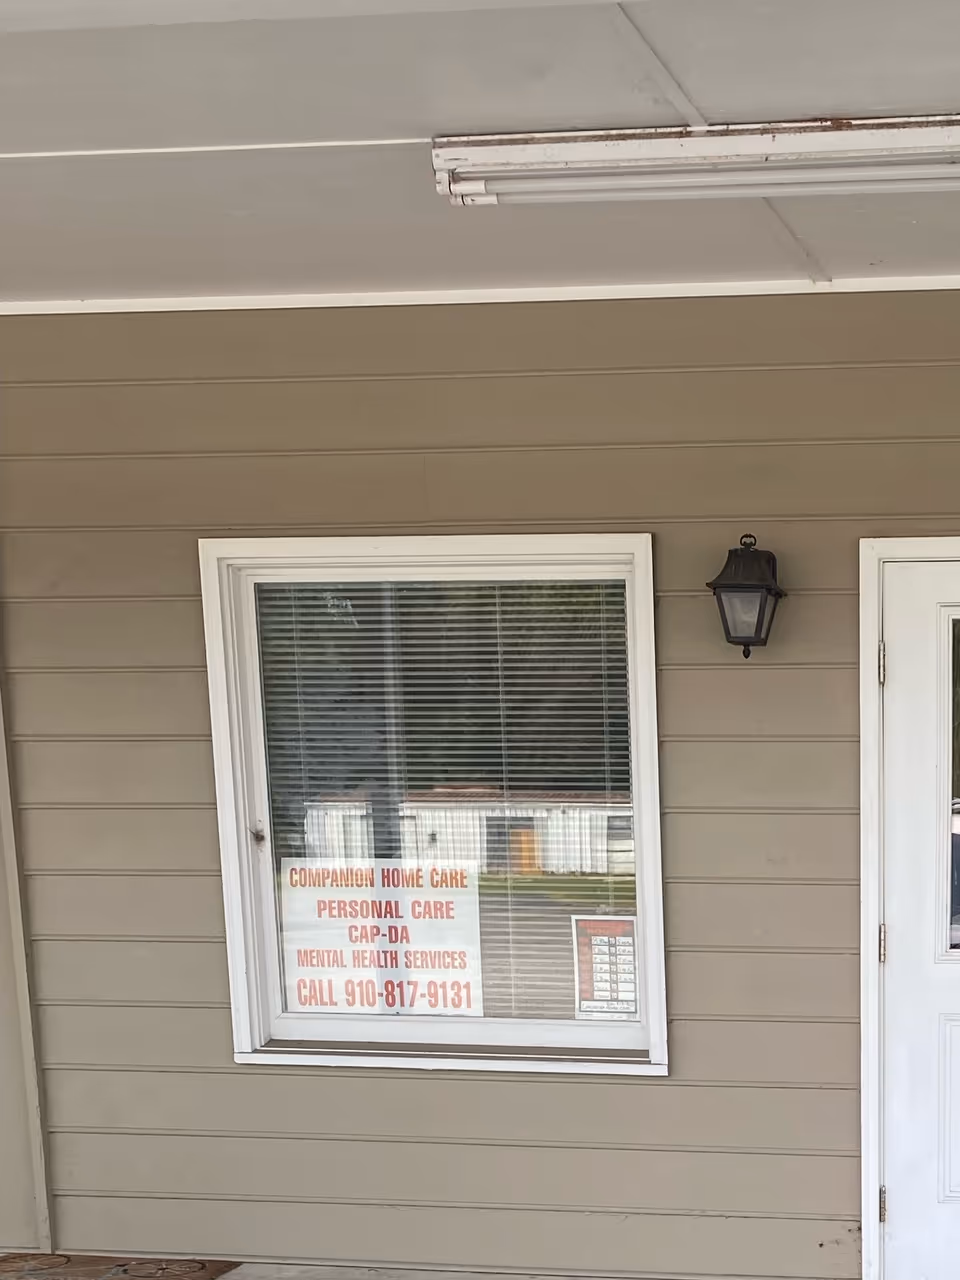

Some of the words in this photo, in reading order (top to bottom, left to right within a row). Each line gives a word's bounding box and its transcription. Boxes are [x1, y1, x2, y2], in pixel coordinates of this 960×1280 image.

[289, 867, 375, 888] COMPANION
[381, 868, 424, 888] HOME
[430, 867, 468, 889] CARE
[316, 900, 404, 919] PERSONAL
[411, 901, 455, 920] CARE
[348, 925, 410, 944] CAP-DA
[297, 949, 347, 968] MENTAL
[352, 949, 399, 969] HEALTH
[404, 950, 468, 970] SERVICES
[297, 978, 338, 1006] CALL
[344, 980, 473, 1009] 910-817-9131
